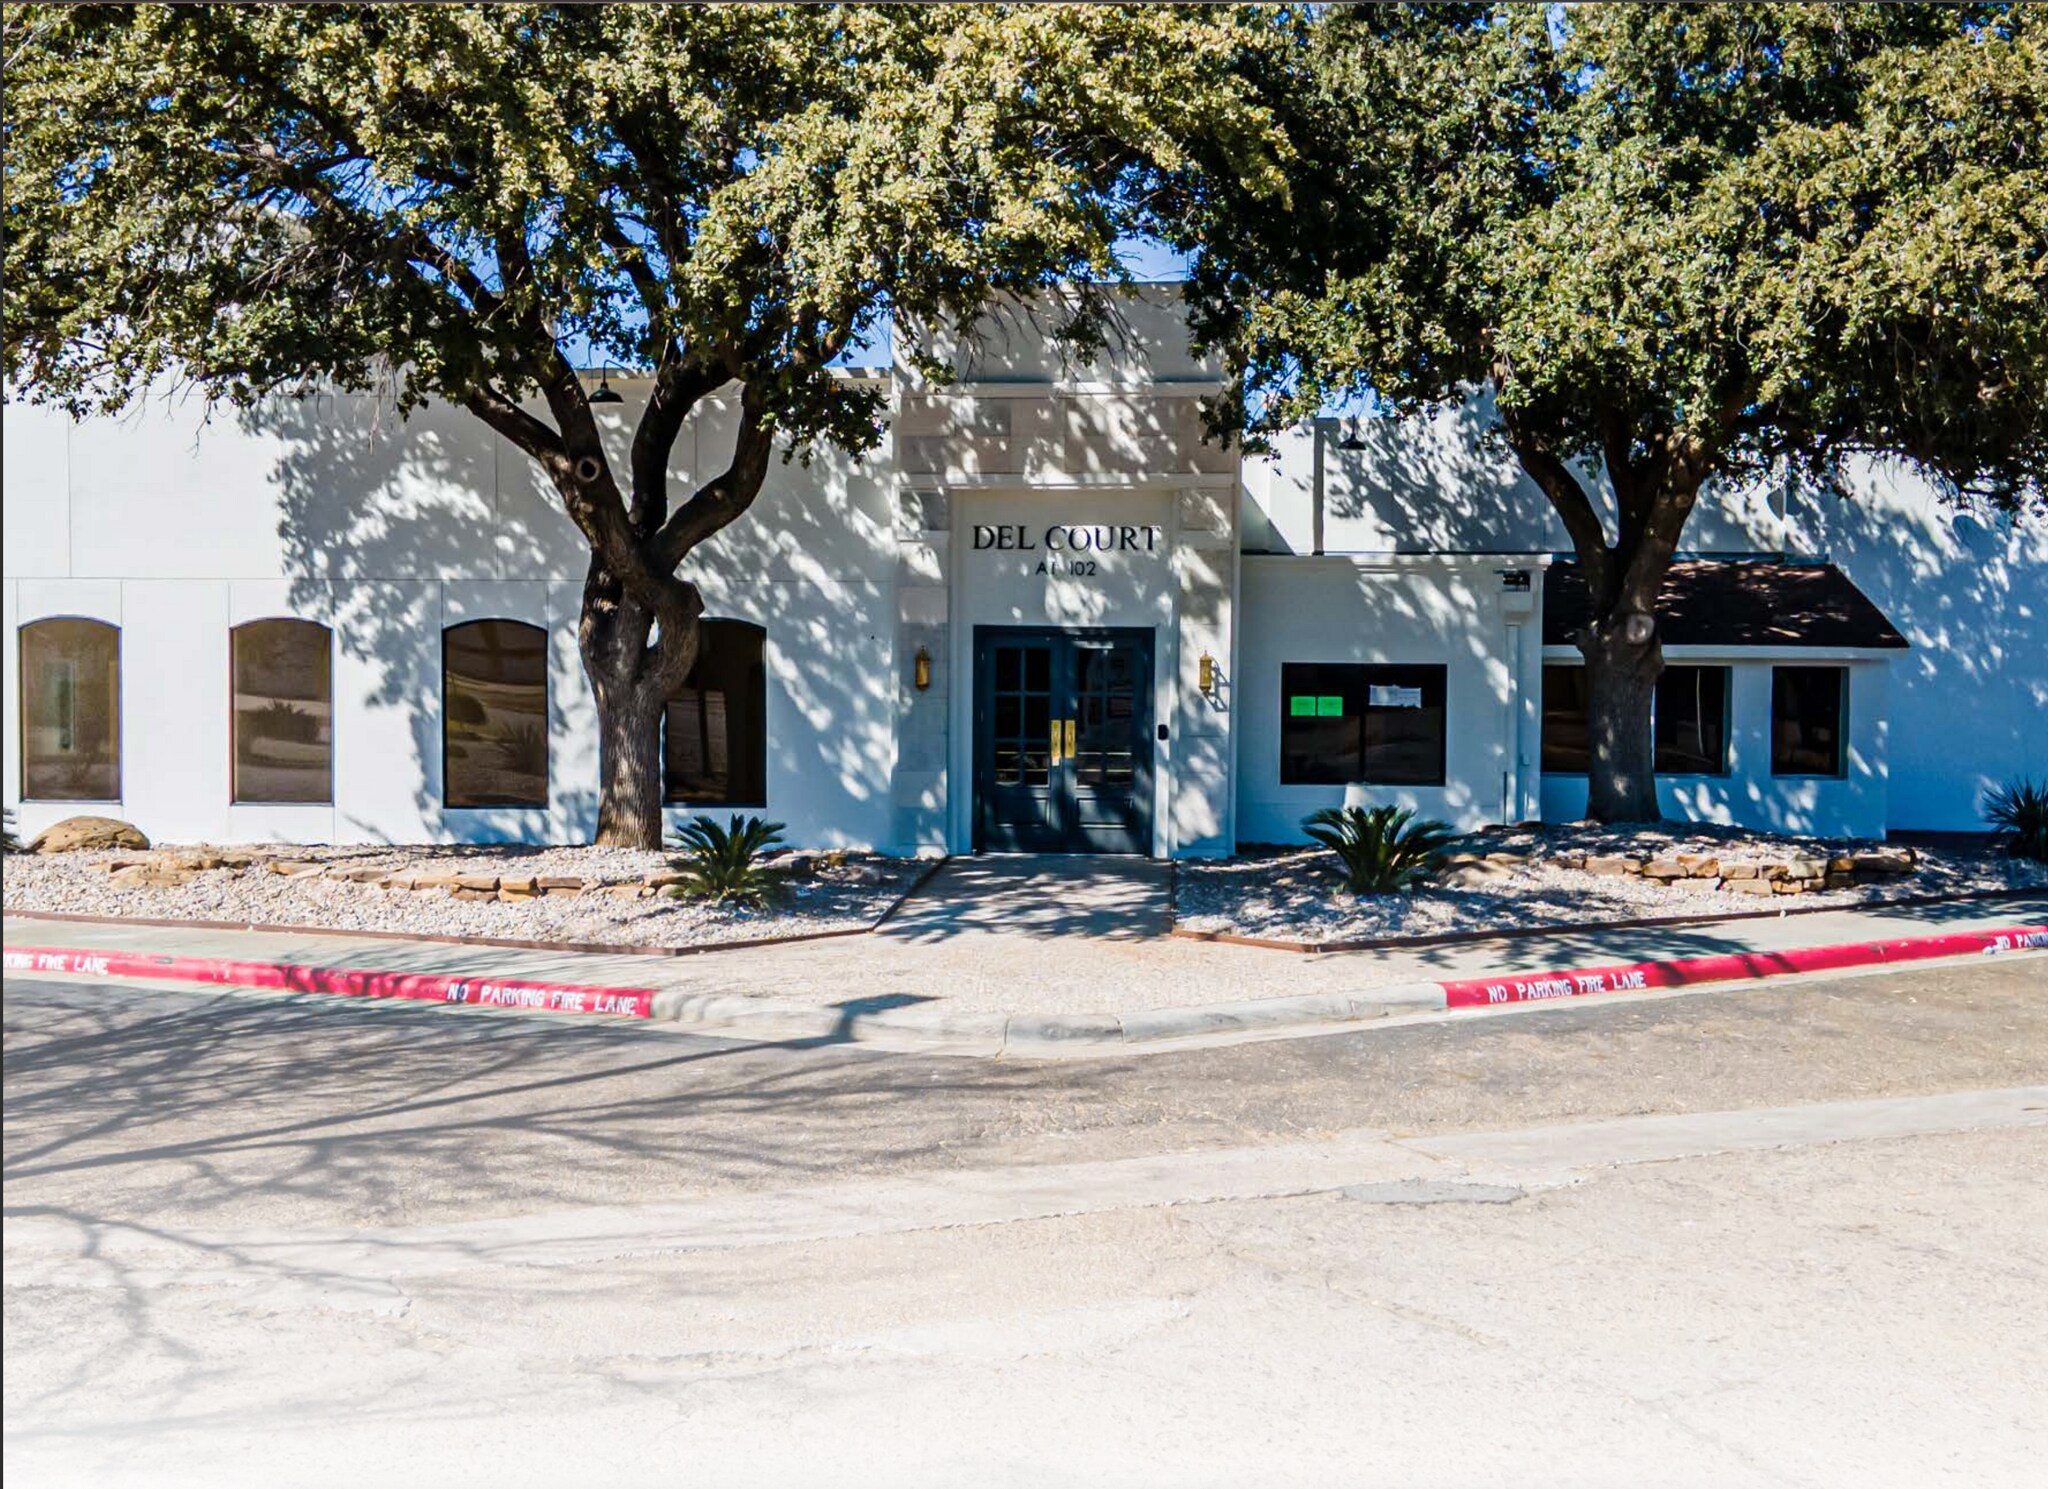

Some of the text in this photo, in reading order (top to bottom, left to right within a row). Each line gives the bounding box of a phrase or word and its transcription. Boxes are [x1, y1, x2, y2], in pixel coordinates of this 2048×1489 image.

[973, 525, 1162, 551] DEL COURT
[1069, 561, 1096, 576] 102
[38, 954, 66, 970] FIRE
[73, 956, 110, 975] LANE
[447, 983, 638, 1015] NO PARKING FIRE LANE
[1487, 970, 1647, 1003] NO PARKING FIRE LANE
